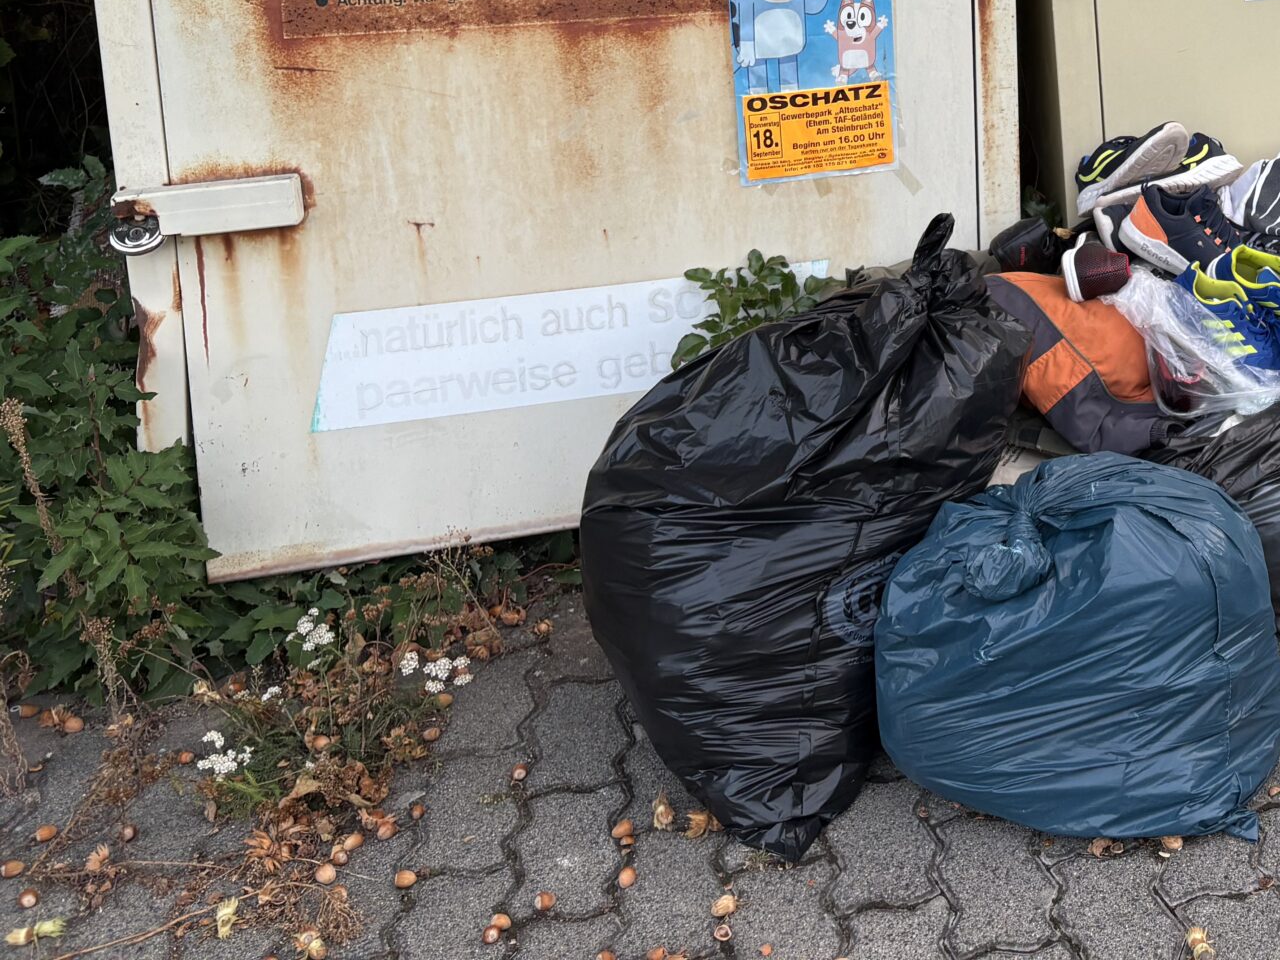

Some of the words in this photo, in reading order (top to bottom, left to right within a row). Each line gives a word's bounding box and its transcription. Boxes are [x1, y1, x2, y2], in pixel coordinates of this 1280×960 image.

[747, 85, 882, 112] OSCHATZ
[781, 109, 832, 122] Gewerbepark
[817, 127, 829, 135] Am
[832, 121, 873, 134] Steinbruch
[876, 120, 885, 129] 16
[754, 129, 779, 149] 18.
[793, 141, 821, 150] Beginn
[838, 134, 865, 144] 16.00
[868, 132, 886, 141] Uhr
[753, 150, 781, 161] September
[1140, 242, 1170, 265] Bench
[541, 294, 628, 336] auch
[357, 356, 577, 420] paarweise
